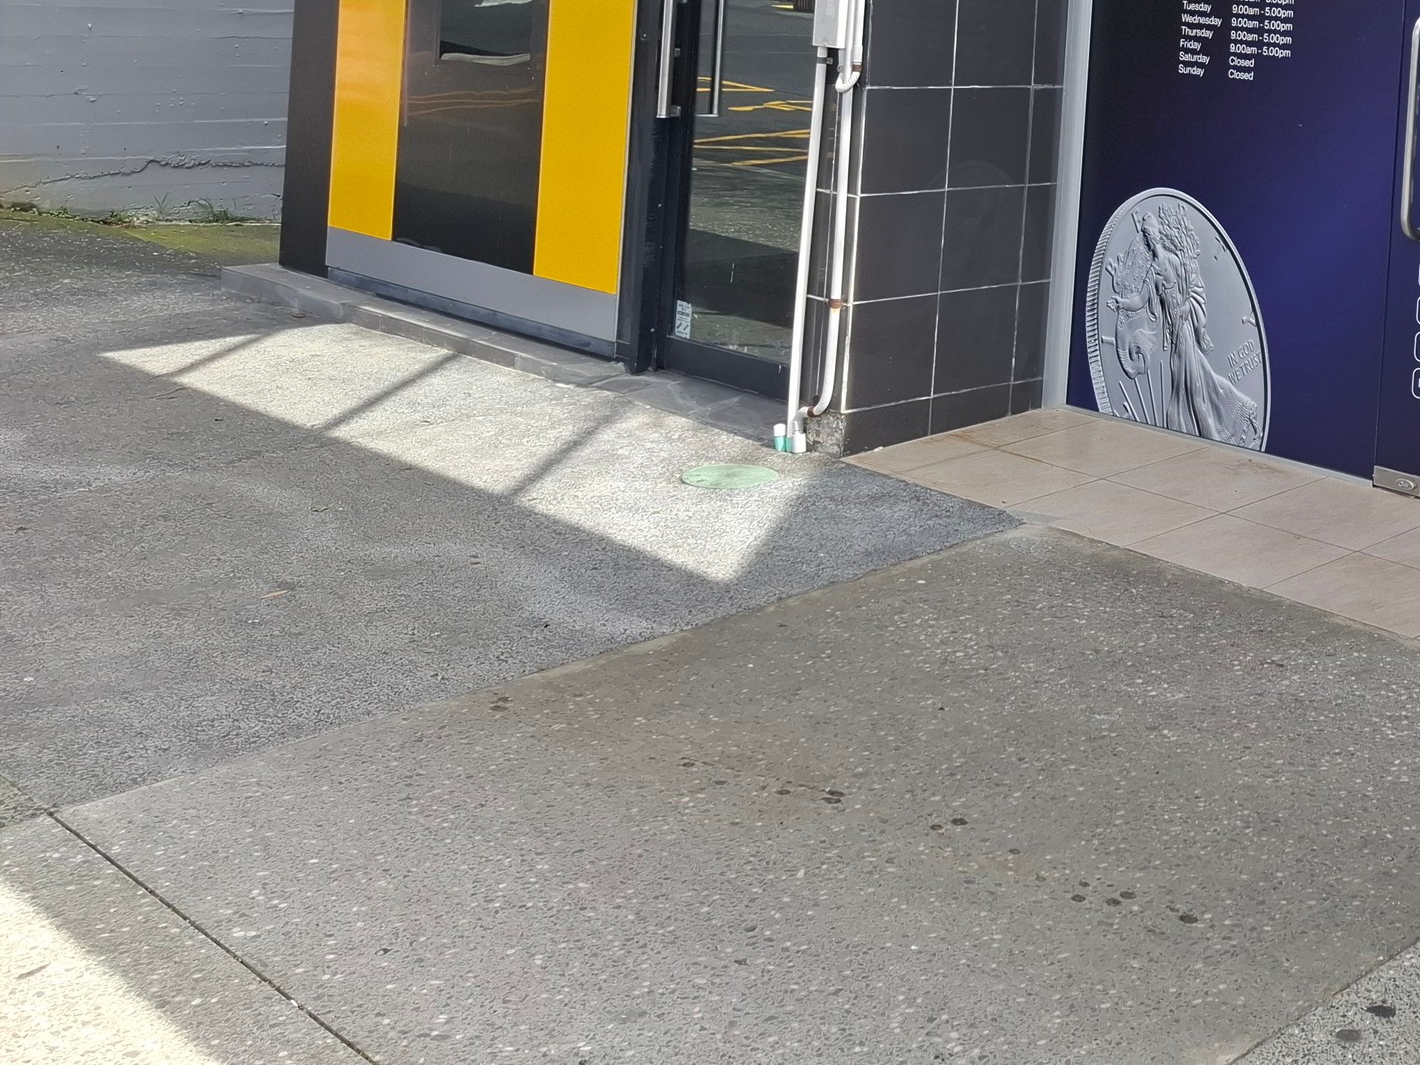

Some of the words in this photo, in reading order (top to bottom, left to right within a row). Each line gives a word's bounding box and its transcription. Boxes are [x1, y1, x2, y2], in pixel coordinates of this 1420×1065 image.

[1183, 1, 1211, 13] Tuesday
[1182, 13, 1222, 27] Wednesday
[1181, 26, 1213, 39] Thursday
[1180, 39, 1201, 51] Friday
[1179, 52, 1210, 64] Saturday
[1229, 56, 1254, 67] Closed
[1179, 64, 1204, 77] Sunday
[1228, 69, 1253, 80] Closed
[1227, 351, 1238, 368] IN
[1238, 339, 1254, 360] GOD
[1228, 368, 1241, 385] WE
[1240, 350, 1261, 376] TRUST
